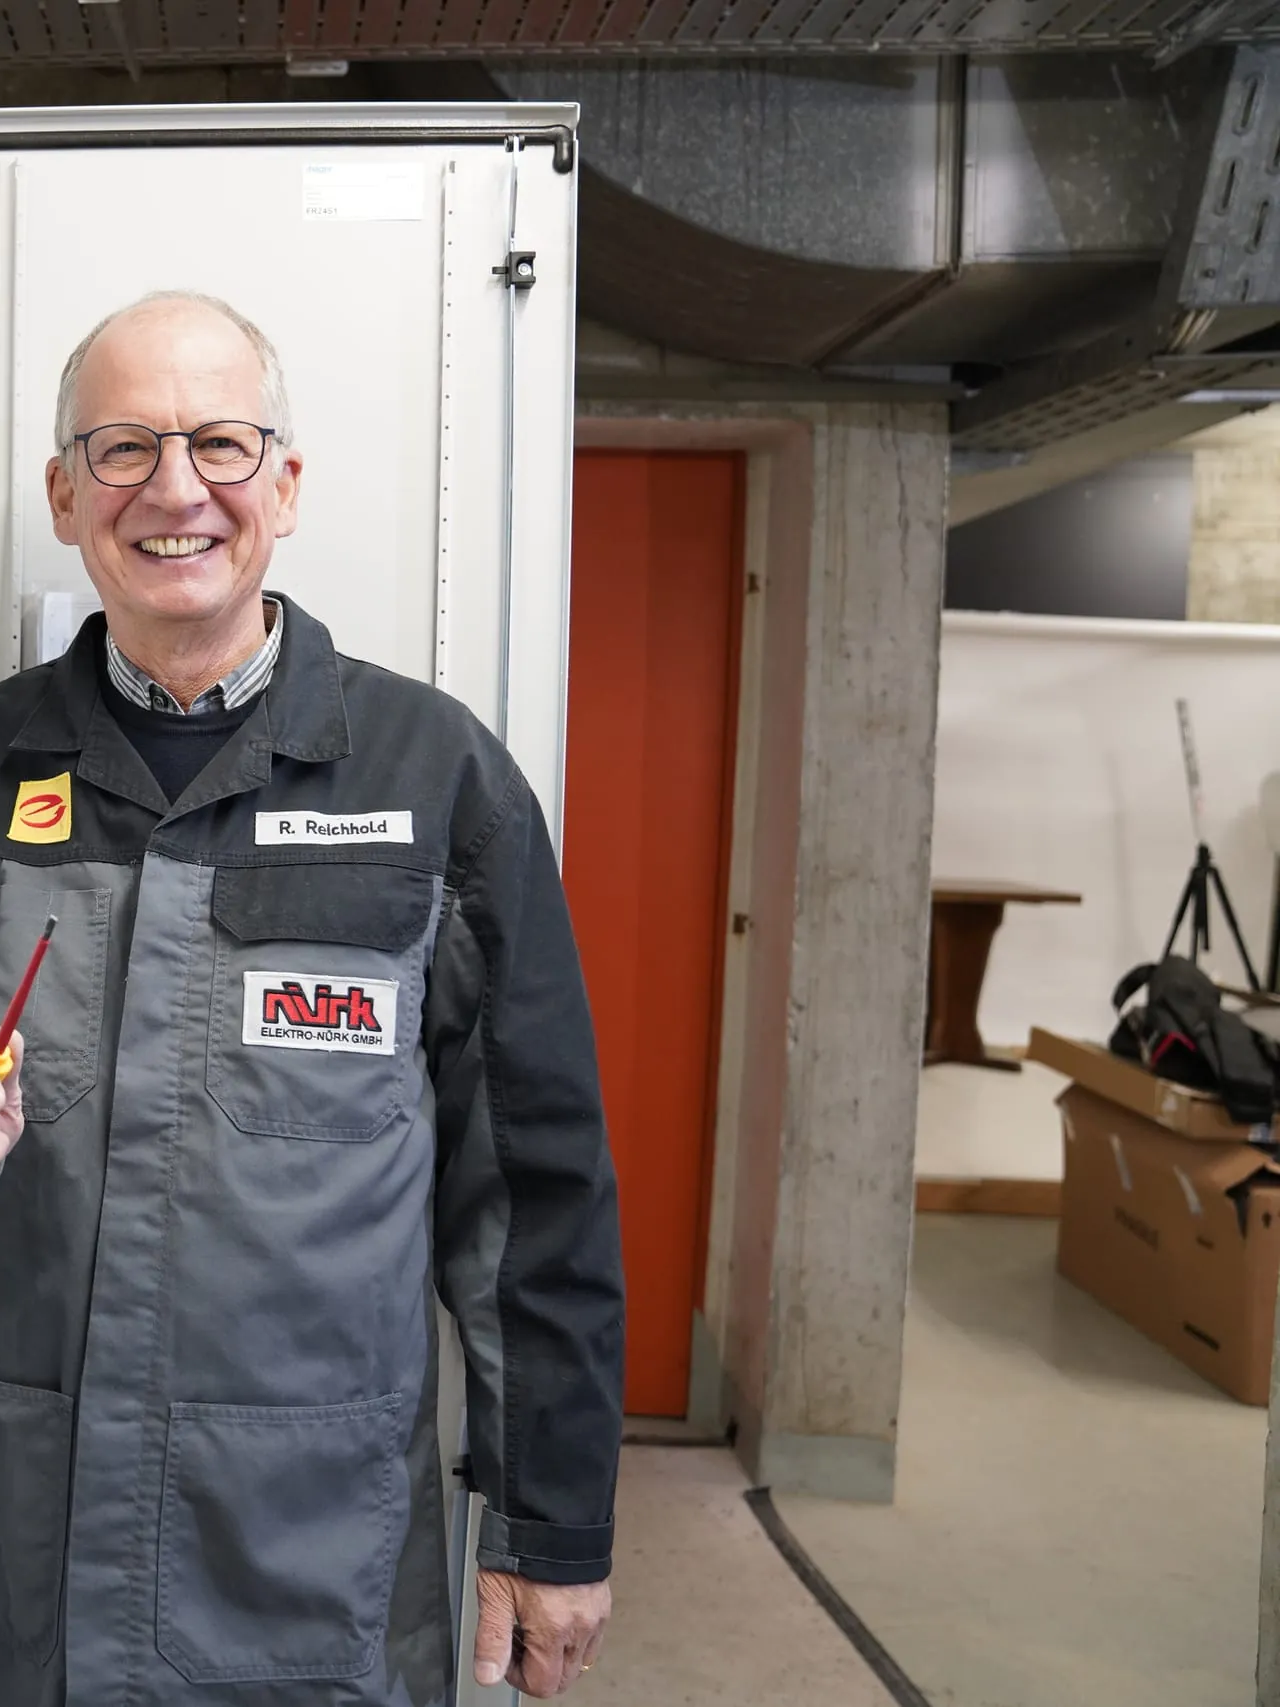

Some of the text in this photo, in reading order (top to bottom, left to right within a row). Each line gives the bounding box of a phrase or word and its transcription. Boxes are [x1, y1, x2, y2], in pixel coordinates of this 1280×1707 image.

[279, 819, 388, 836] R. Reichhold
[260, 1026, 349, 1042] ELEKTRO-NÜRK
